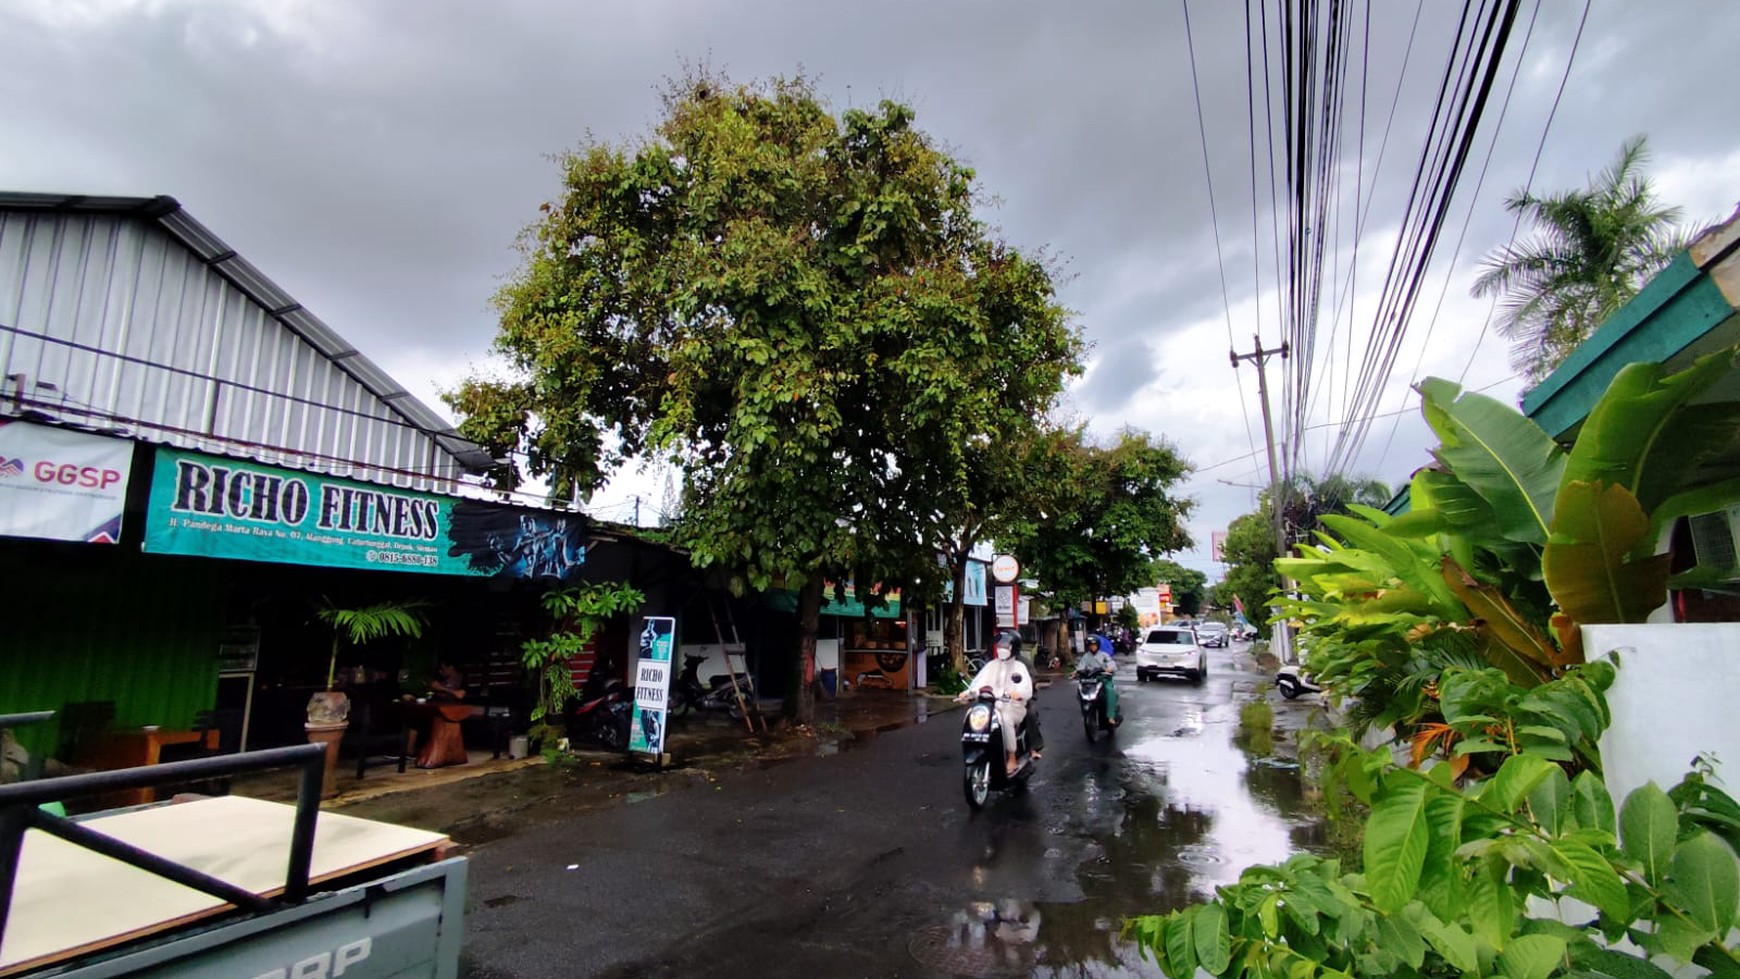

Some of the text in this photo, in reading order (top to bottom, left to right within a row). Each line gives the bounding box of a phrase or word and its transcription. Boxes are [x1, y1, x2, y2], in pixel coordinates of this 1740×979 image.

[34, 461, 121, 490] GGSP
[173, 458, 439, 542] RICHO FITNESS
[182, 519, 223, 532] Pandega
[641, 667, 663, 683] RICHO
[636, 687, 664, 702] FITNESS
